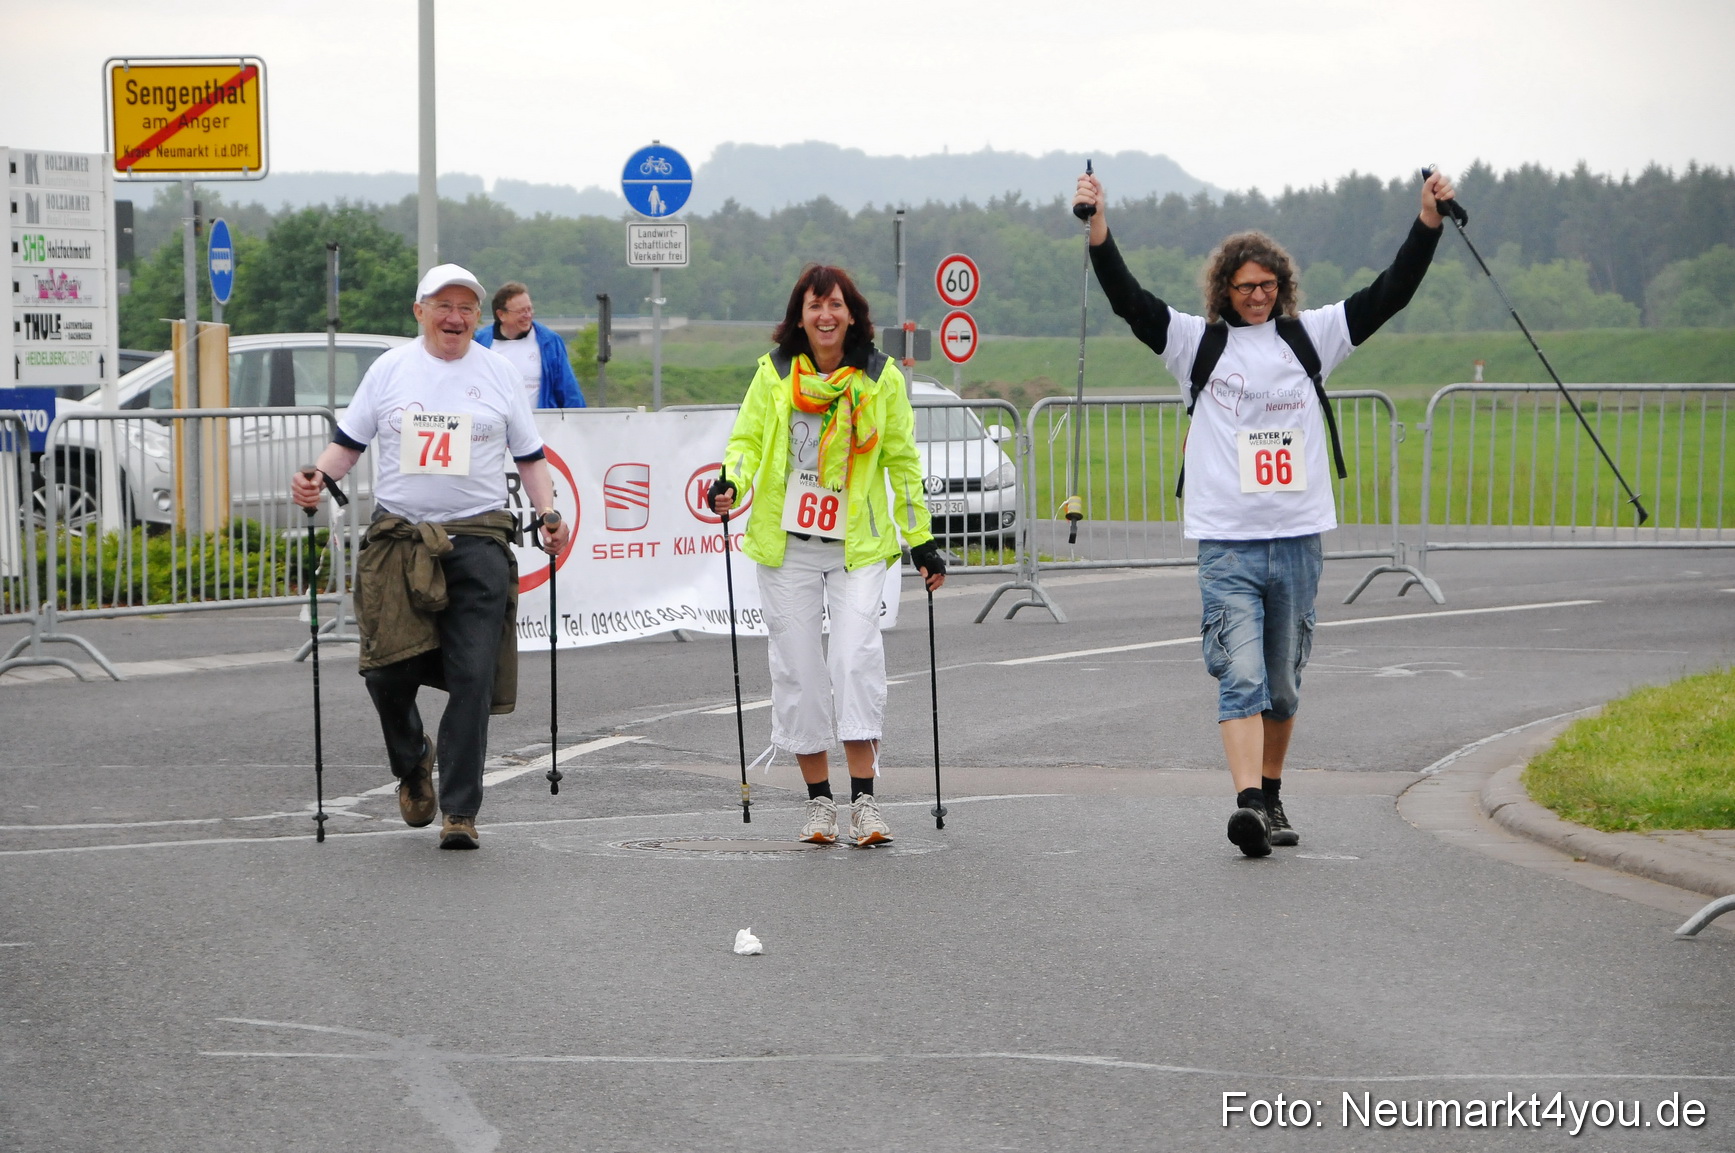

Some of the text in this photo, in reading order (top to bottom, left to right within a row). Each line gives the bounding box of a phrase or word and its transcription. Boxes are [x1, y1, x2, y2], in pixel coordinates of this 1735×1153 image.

[125, 78, 246, 112] Sengenthal
[142, 113, 230, 133] am Anger
[156, 144, 209, 158] Neumarkt
[637, 228, 678, 239] Landwirt-
[633, 240, 682, 250] schaftlicher
[633, 251, 683, 261] Verkehr frei
[946, 269, 970, 292] 60
[24, 313, 61, 341] THULE
[1265, 399, 1306, 412] Neumark
[413, 414, 445, 423] MEYER
[1249, 431, 1280, 440] MEYER
[417, 431, 452, 467] 74
[1255, 448, 1293, 486] 66
[796, 491, 840, 532] 68
[592, 541, 661, 560] SEAT
[673, 535, 696, 556] KIA
[561, 613, 589, 637] Tel.
